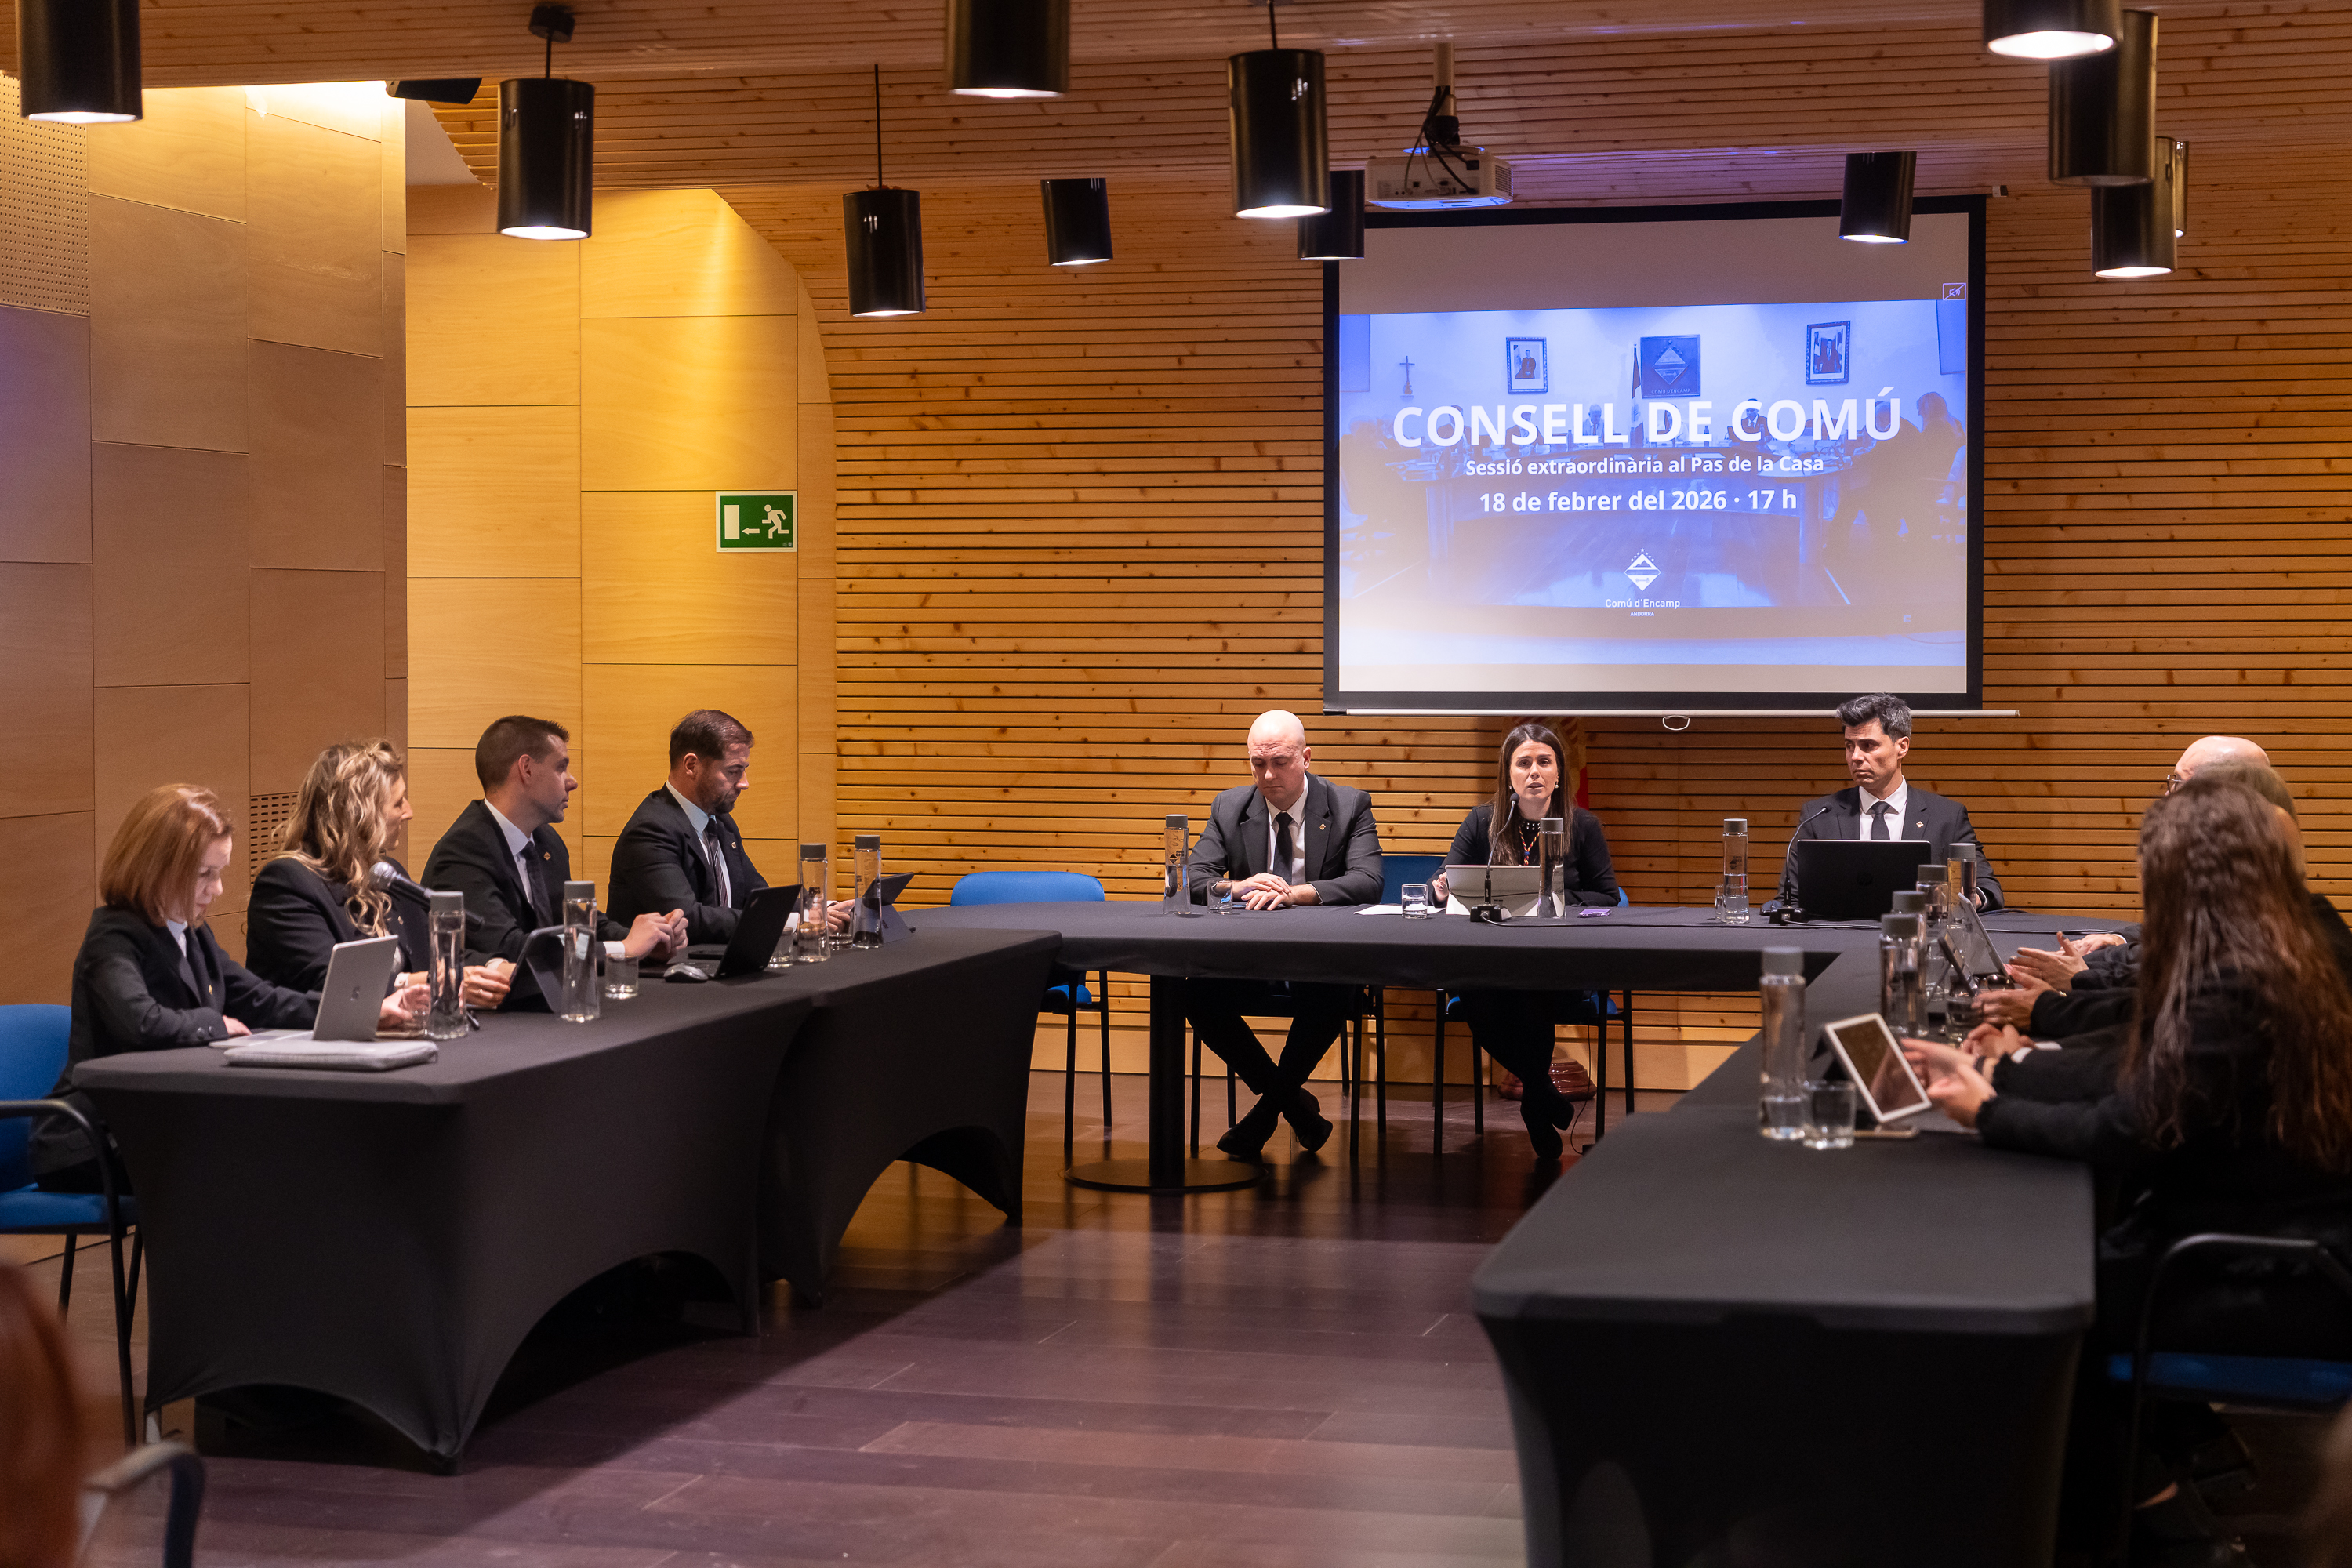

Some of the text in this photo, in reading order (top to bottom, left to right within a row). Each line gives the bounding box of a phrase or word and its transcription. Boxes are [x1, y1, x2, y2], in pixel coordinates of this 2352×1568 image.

[1393, 387, 1900, 448] CONSELL DE COMÚ
[1466, 455, 1824, 476] Sessió extraordinària al Pas de la Casa
[1479, 492, 1506, 512] 18
[1512, 492, 1541, 512] de
[1547, 491, 1622, 511] febrer
[1628, 490, 1664, 510] del
[1671, 490, 1727, 510] 2026
[1748, 490, 1775, 509] 17
[1782, 489, 1797, 509] h
[1605, 598, 1680, 609] Comú d'Encamp
